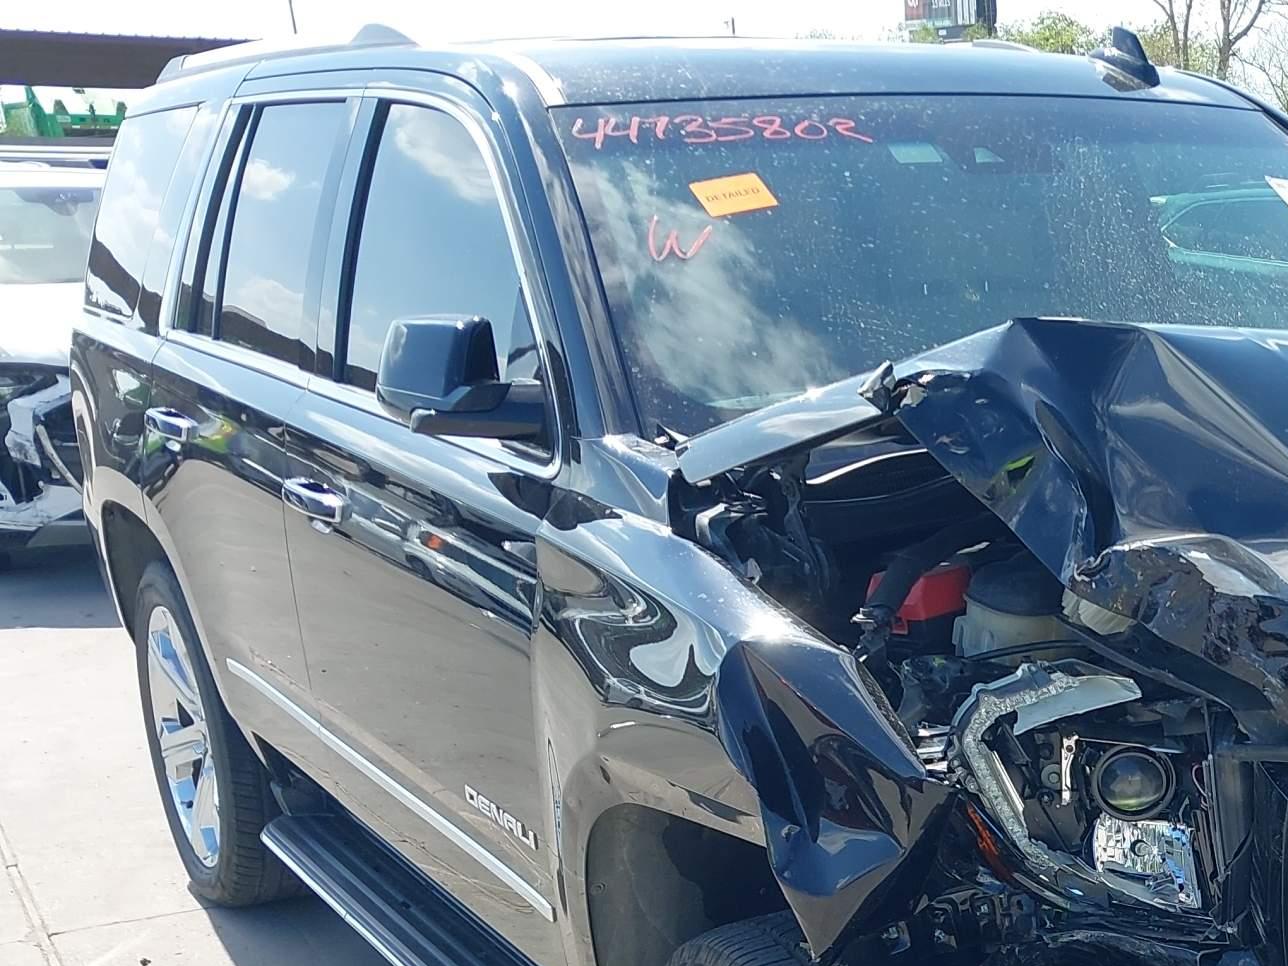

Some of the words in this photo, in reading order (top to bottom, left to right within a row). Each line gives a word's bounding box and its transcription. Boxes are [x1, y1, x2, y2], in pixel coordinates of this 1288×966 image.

[571, 115, 874, 150] 44735802
[705, 186, 761, 203] DETAILED
[464, 784, 539, 851] DENALI
